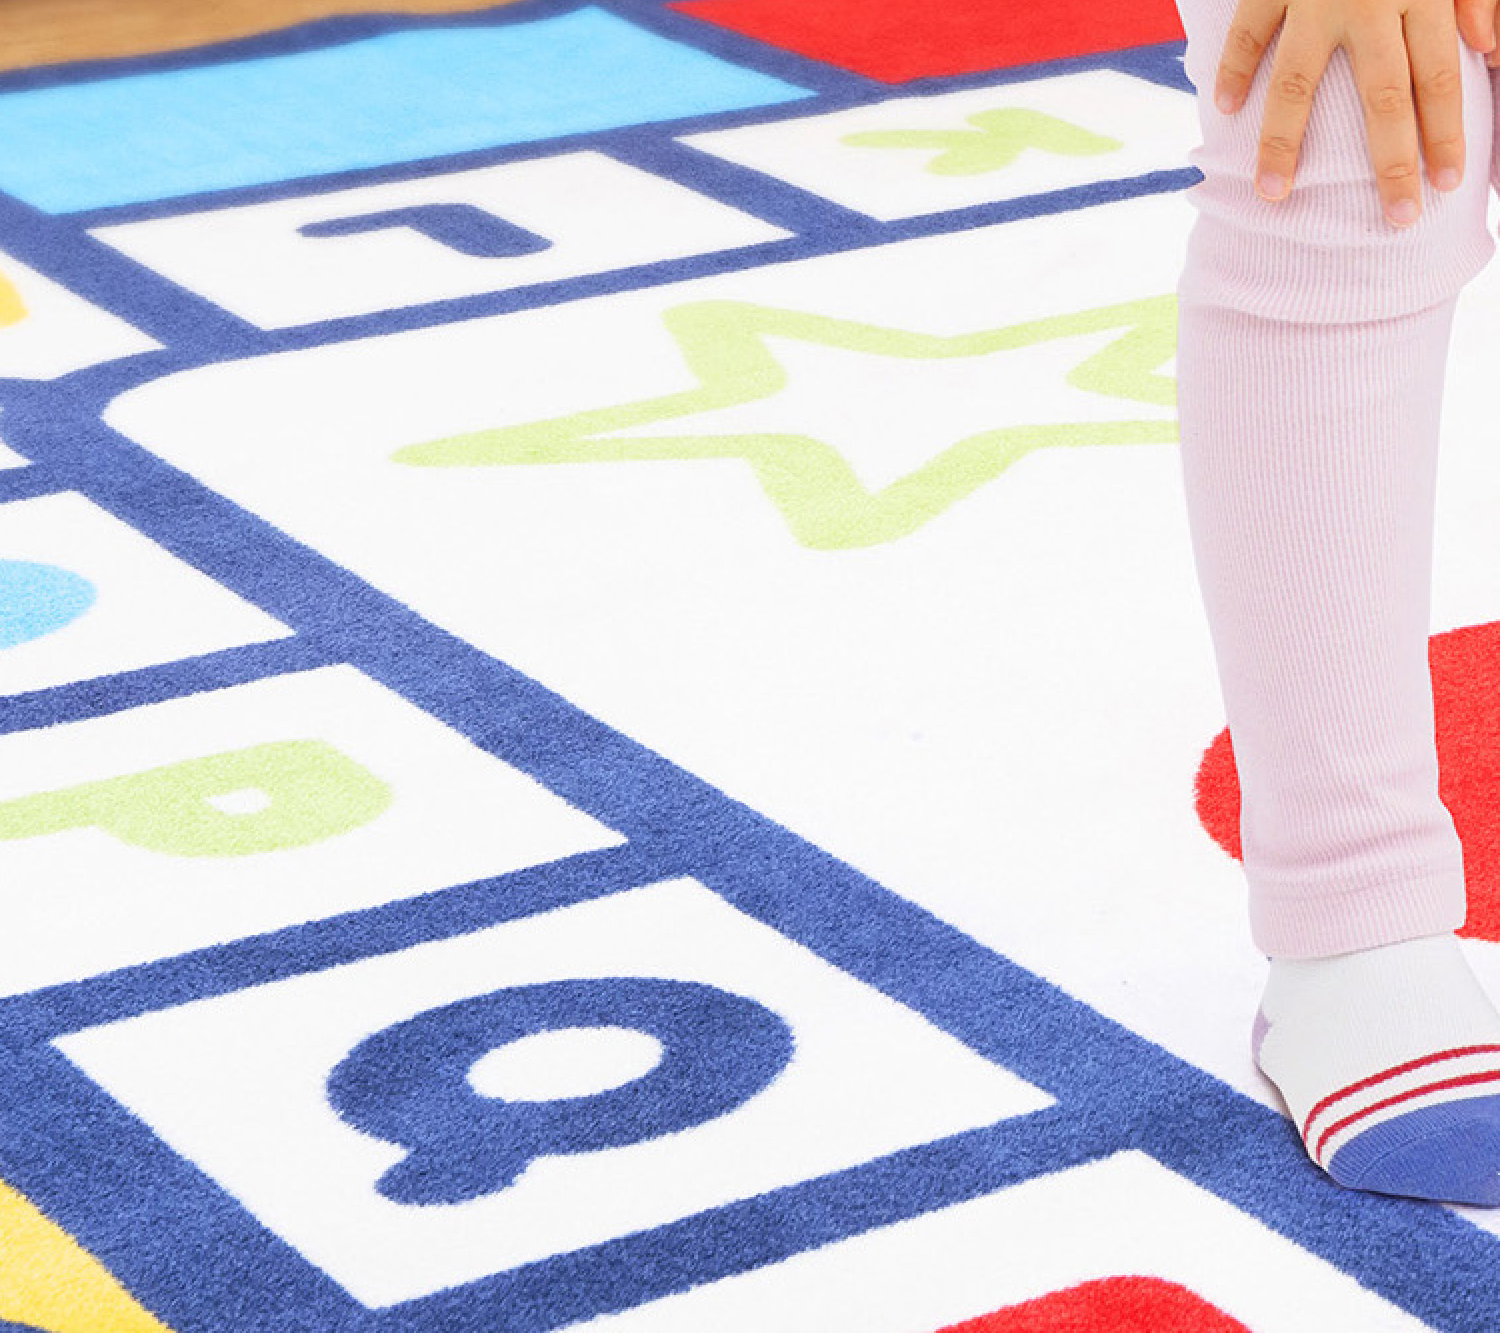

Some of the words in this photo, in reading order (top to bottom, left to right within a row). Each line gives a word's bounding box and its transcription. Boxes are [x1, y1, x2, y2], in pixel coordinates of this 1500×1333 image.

[840, 107, 1124, 177] K
[296, 201, 554, 259] L
[322, 975, 798, 1209] Q
